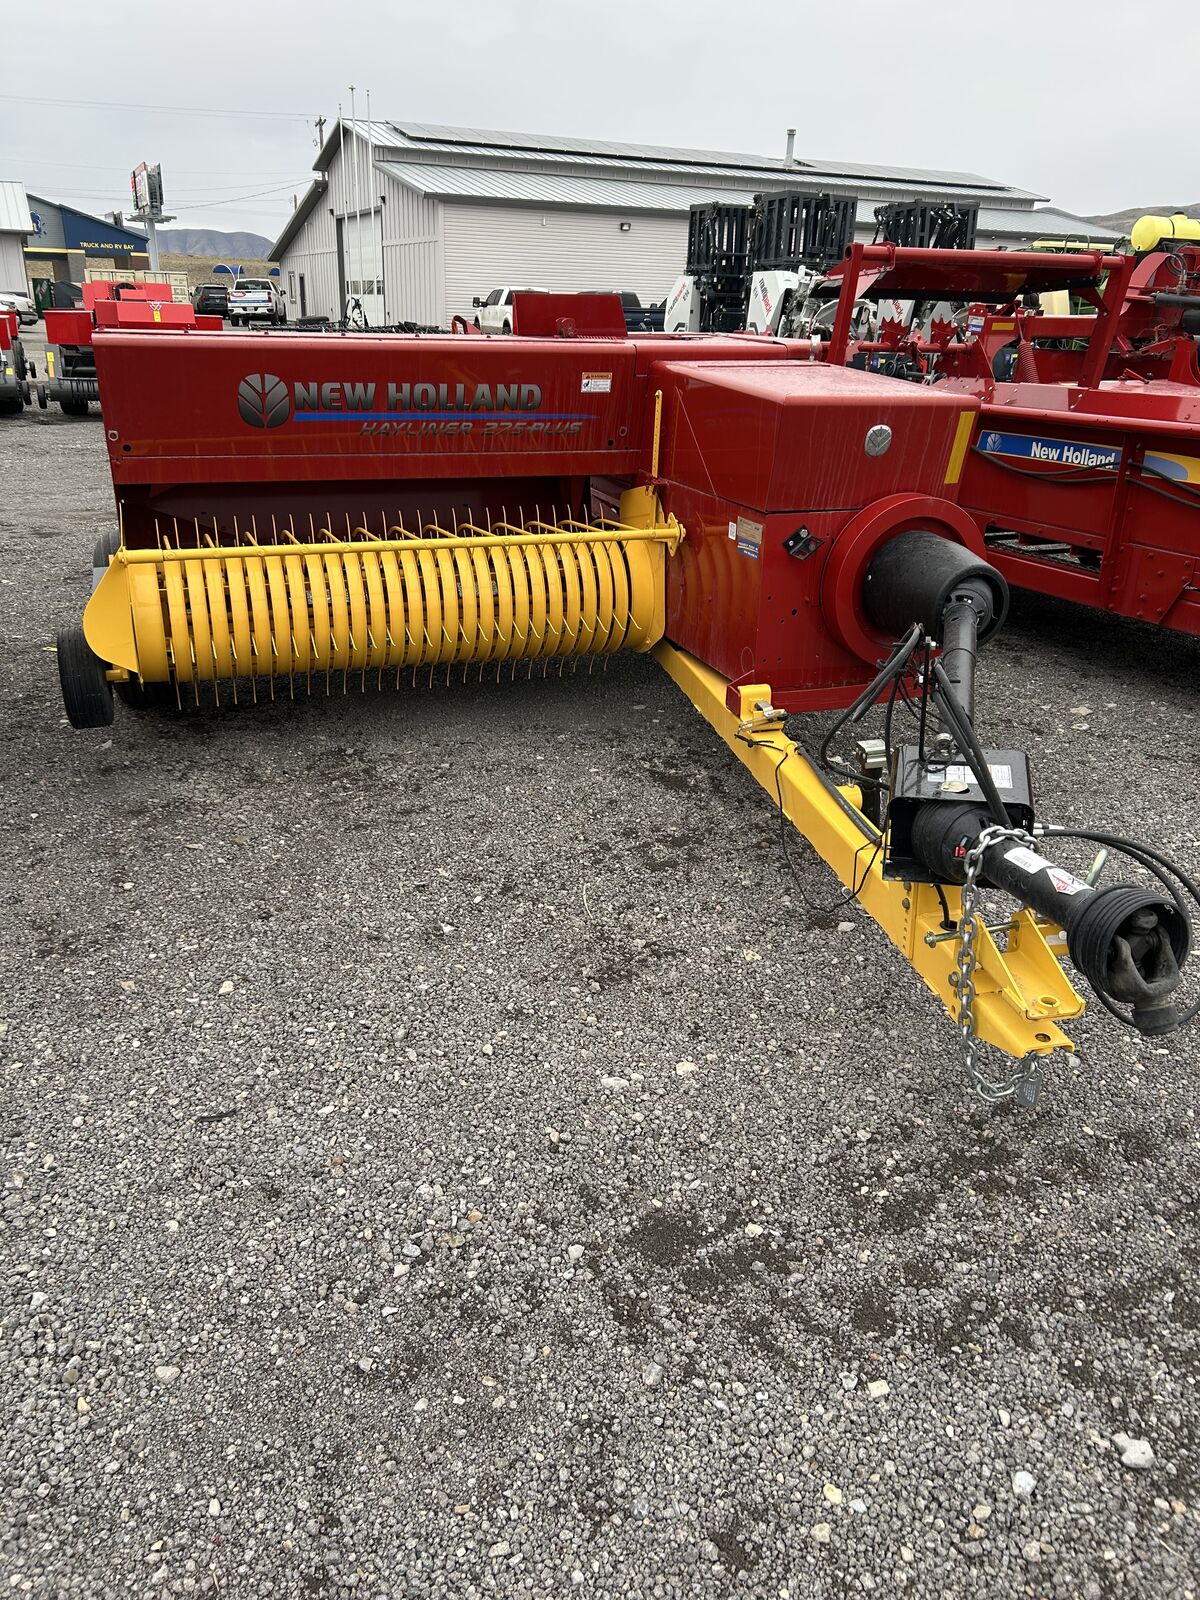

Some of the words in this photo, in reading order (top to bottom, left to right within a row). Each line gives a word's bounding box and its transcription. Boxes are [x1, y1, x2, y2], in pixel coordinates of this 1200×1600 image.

[293, 381, 376, 411] NEW
[387, 382, 543, 412] HOLLAND
[359, 421, 474, 438] HAYLINER
[481, 421, 527, 436] 275
[1030, 441, 1060, 461] New
[1062, 445, 1116, 469] Holland
